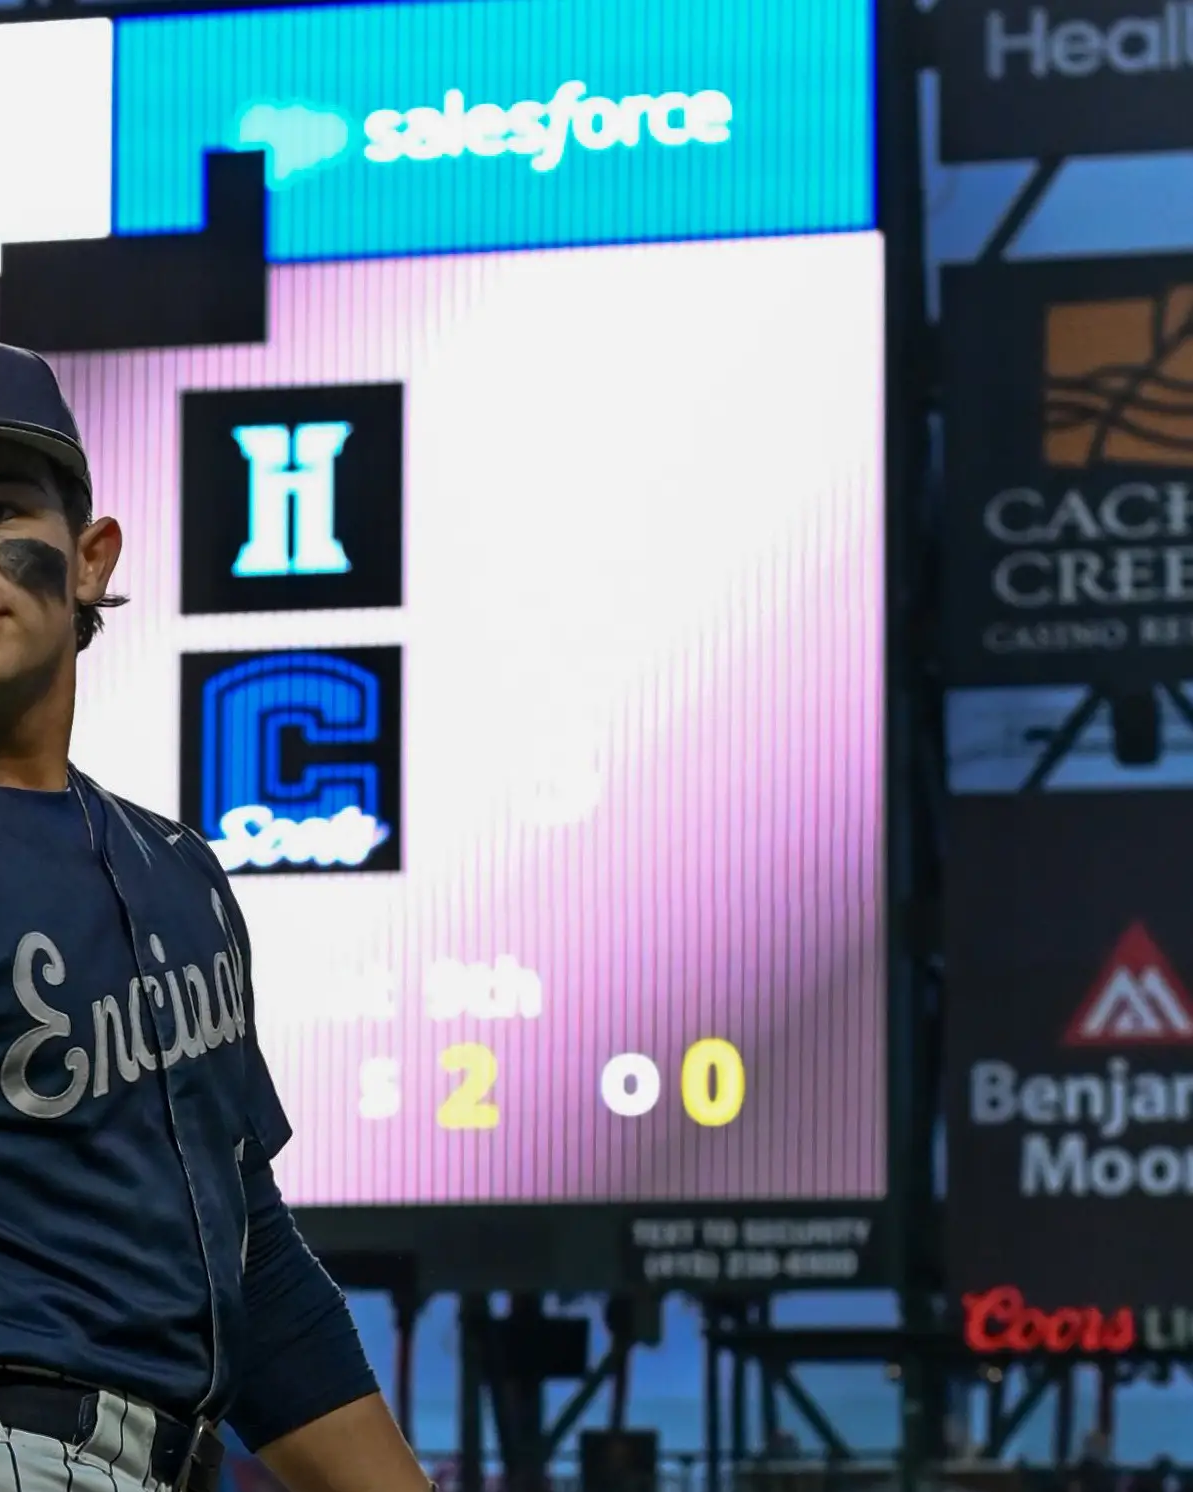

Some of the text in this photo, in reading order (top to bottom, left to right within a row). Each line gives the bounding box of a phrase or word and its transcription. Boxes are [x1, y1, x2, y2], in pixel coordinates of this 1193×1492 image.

[363, 80, 734, 172] salesforce
[232, 419, 353, 577] H
[201, 652, 381, 842] C
[436, 1042, 500, 1130] 2
[680, 1037, 746, 1127] 0
[1020, 1132, 1193, 1198] Moo
[961, 1284, 1137, 1353] Coors
